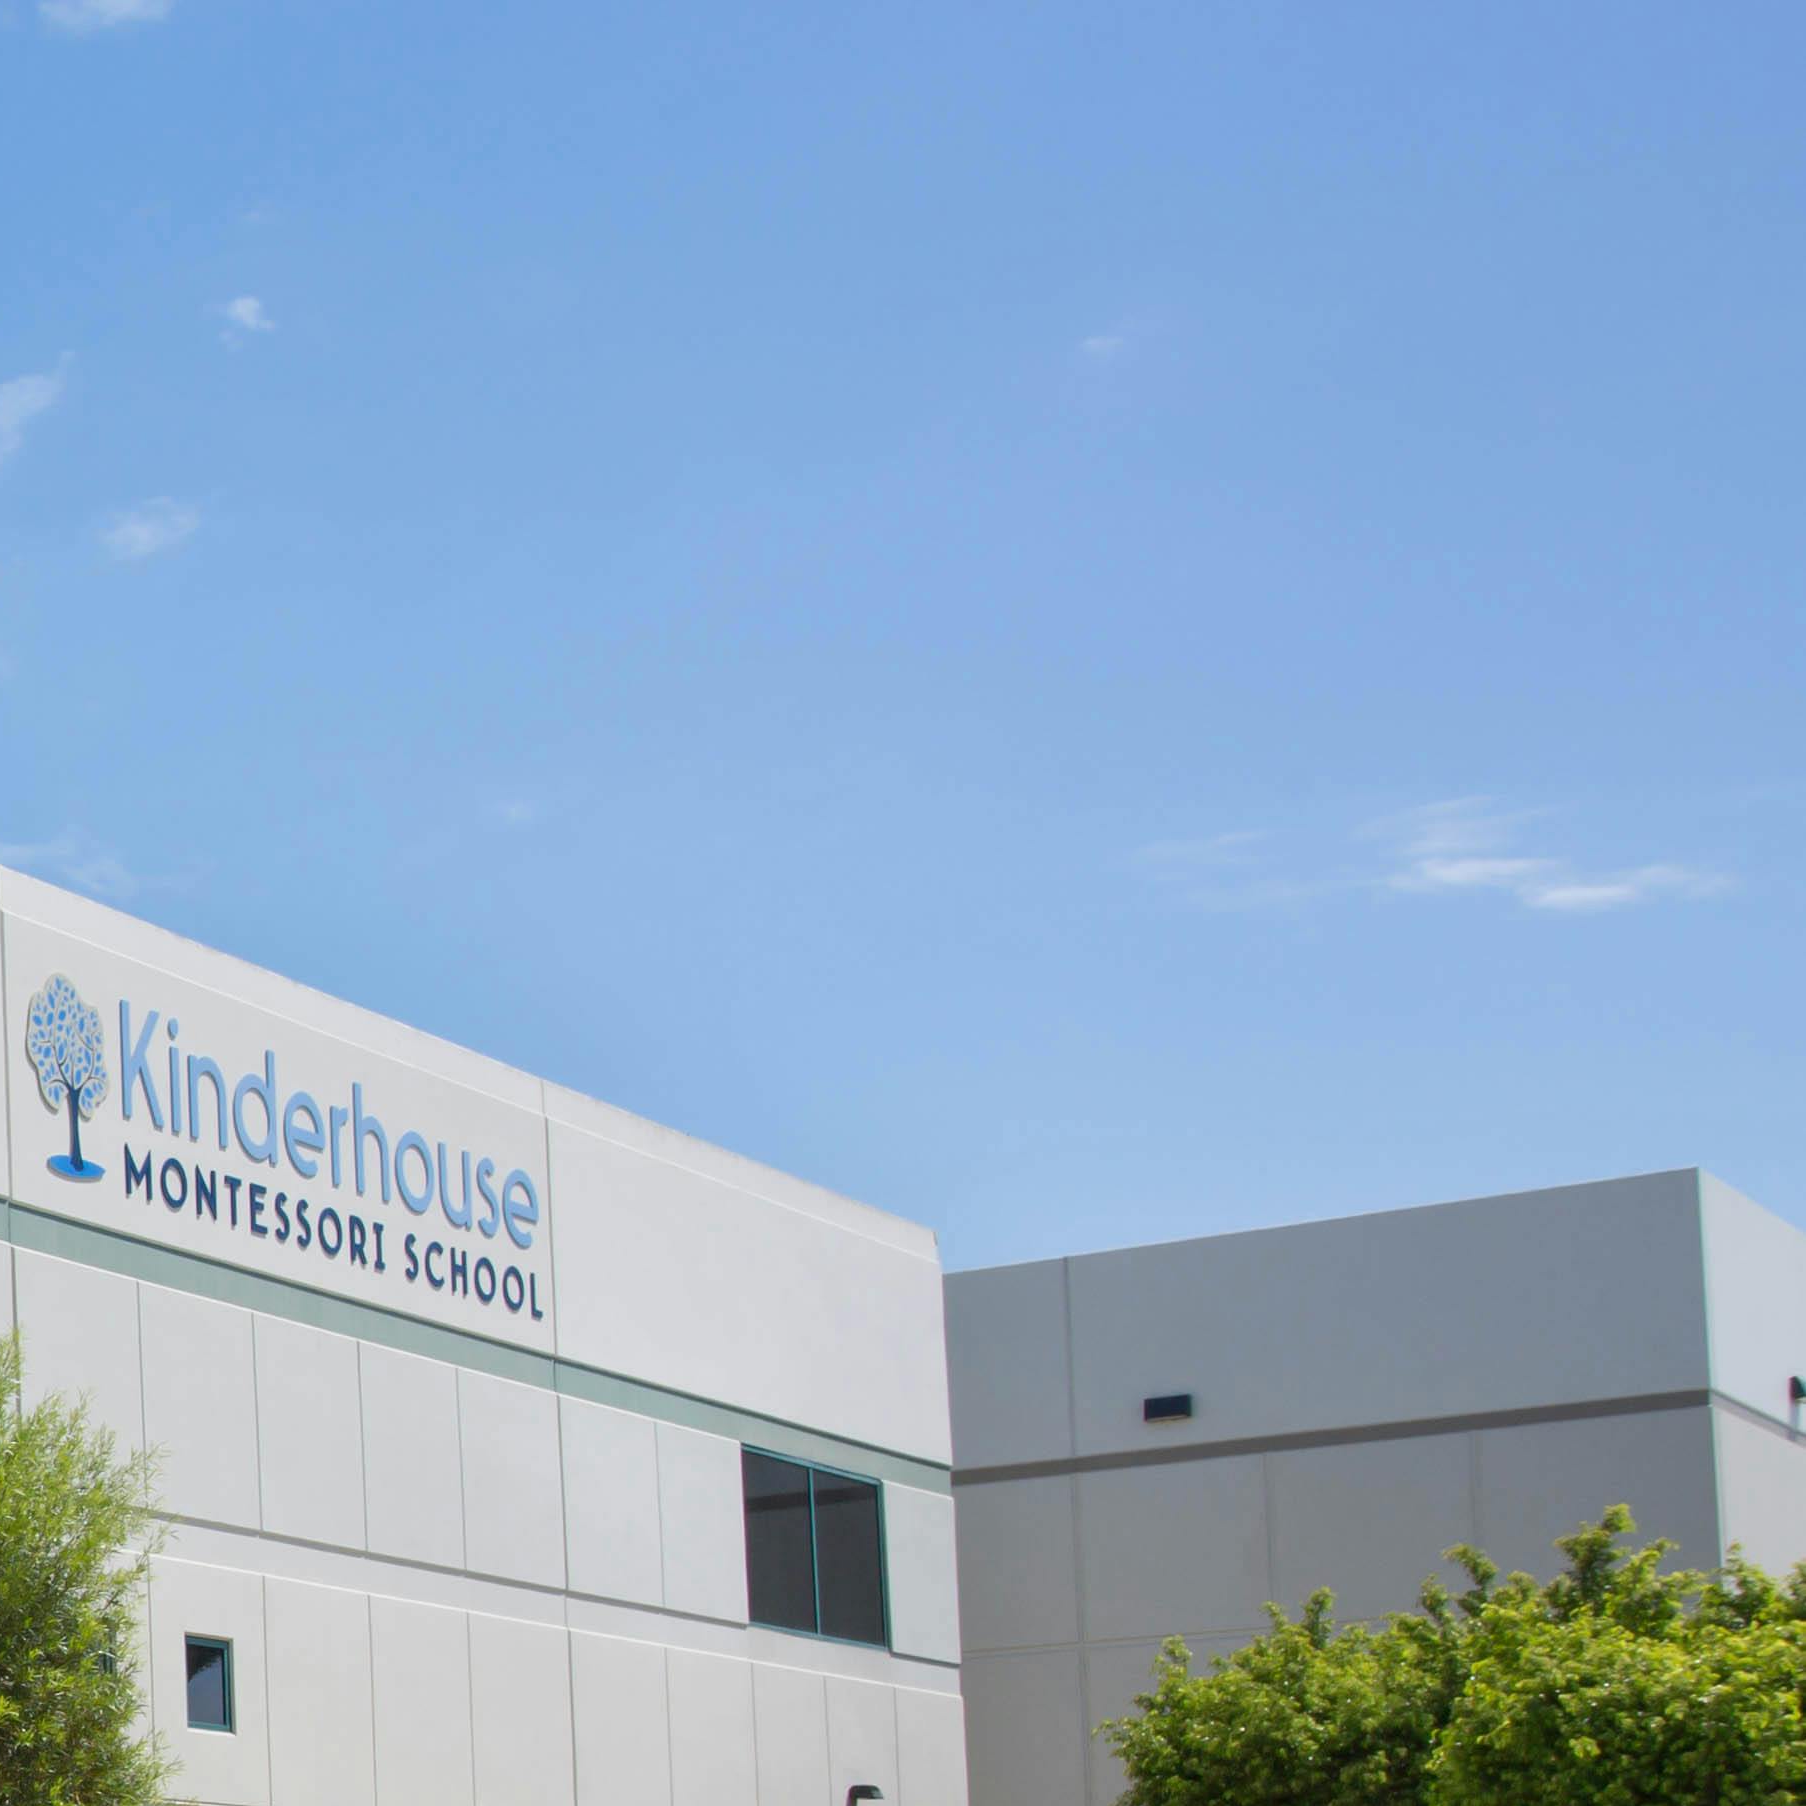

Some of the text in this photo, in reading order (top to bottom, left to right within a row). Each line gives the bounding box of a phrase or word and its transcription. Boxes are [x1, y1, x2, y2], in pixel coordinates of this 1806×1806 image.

[119, 999, 540, 1250] Kinderhouse
[123, 1143, 544, 1322] MONTESSORI SCHOOL
